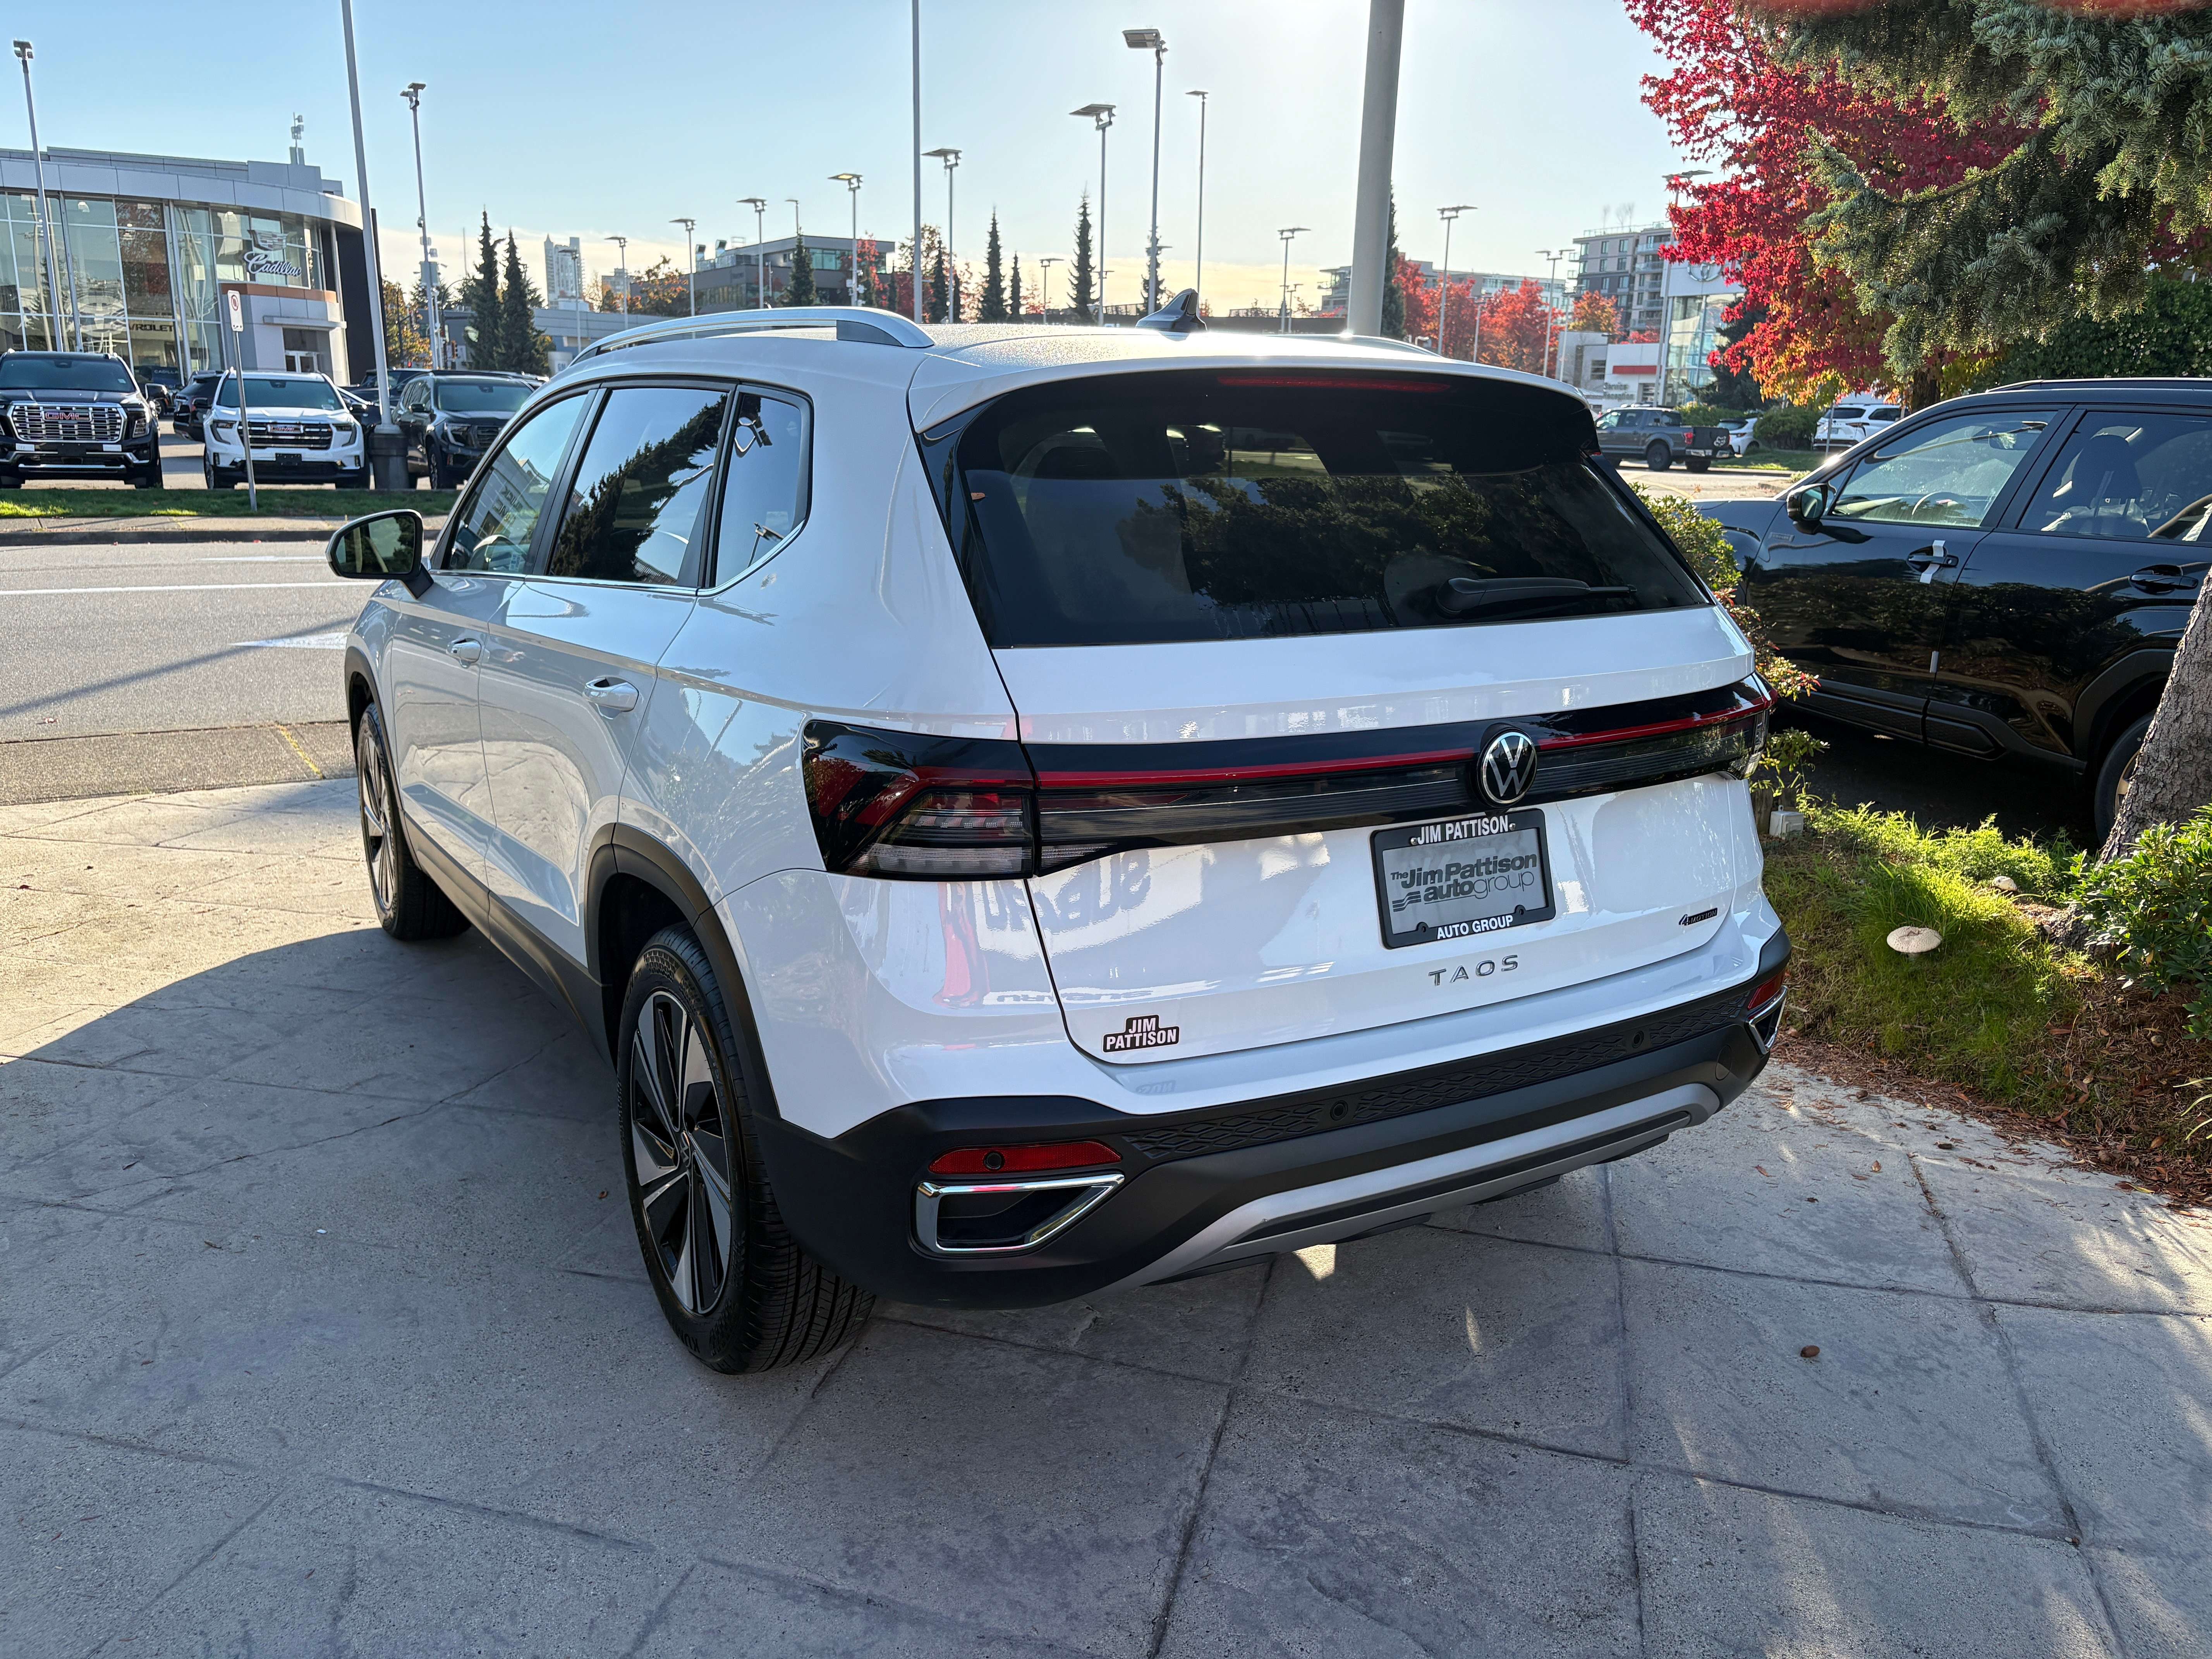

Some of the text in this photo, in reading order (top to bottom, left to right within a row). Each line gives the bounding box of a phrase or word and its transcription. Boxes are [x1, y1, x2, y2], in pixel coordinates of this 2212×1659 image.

[244, 251, 302, 276] Cadillac
[45, 412, 89, 421] GMC
[1417, 815, 1509, 845] JIM PATTISON
[1390, 854, 1537, 888] The Jim Pattison
[1437, 914, 1513, 940] AUTO GROUP
[1679, 908, 1717, 926] 4MOTION
[1428, 954, 1518, 986] TAOS
[1128, 1017, 1156, 1034] JIM
[1106, 1029, 1177, 1050] PATTISON
